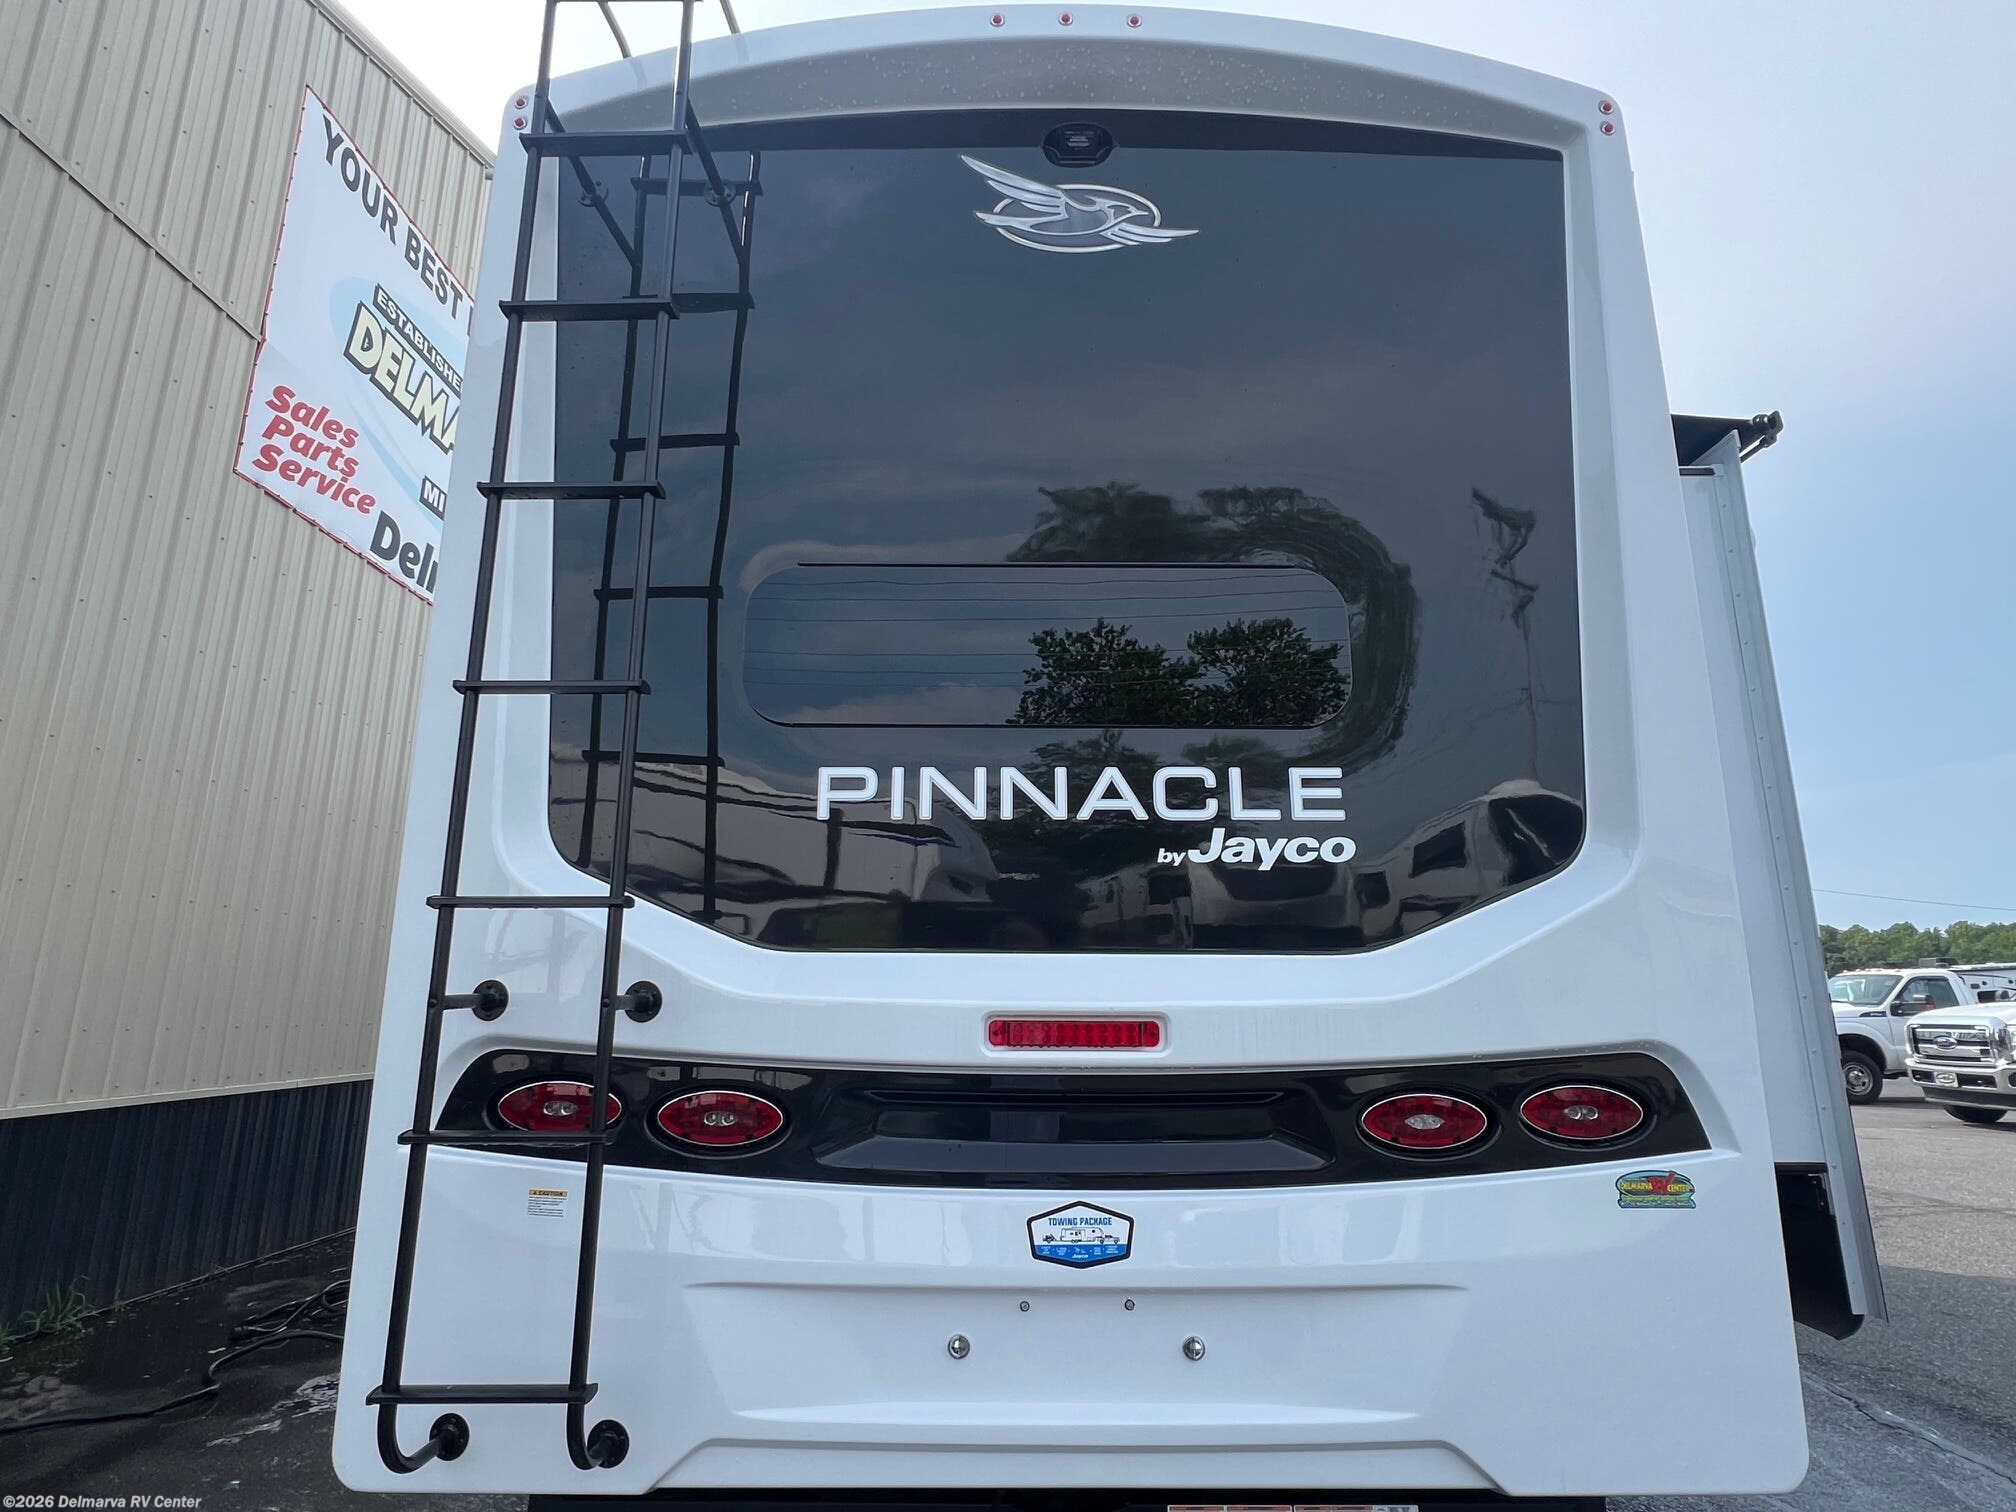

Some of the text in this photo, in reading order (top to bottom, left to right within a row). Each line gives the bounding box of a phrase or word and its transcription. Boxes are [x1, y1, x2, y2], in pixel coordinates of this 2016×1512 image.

[322, 114, 463, 319] YOUR BEST
[376, 287, 462, 393] ESTABLISHE
[262, 415, 360, 478] Parts
[265, 385, 360, 448] Sales
[252, 444, 376, 514] Service
[816, 766, 1347, 821] PINNACLE
[1157, 827, 1357, 871] by Jayco
[1048, 1217, 1113, 1226] TOWING PACKAGE
